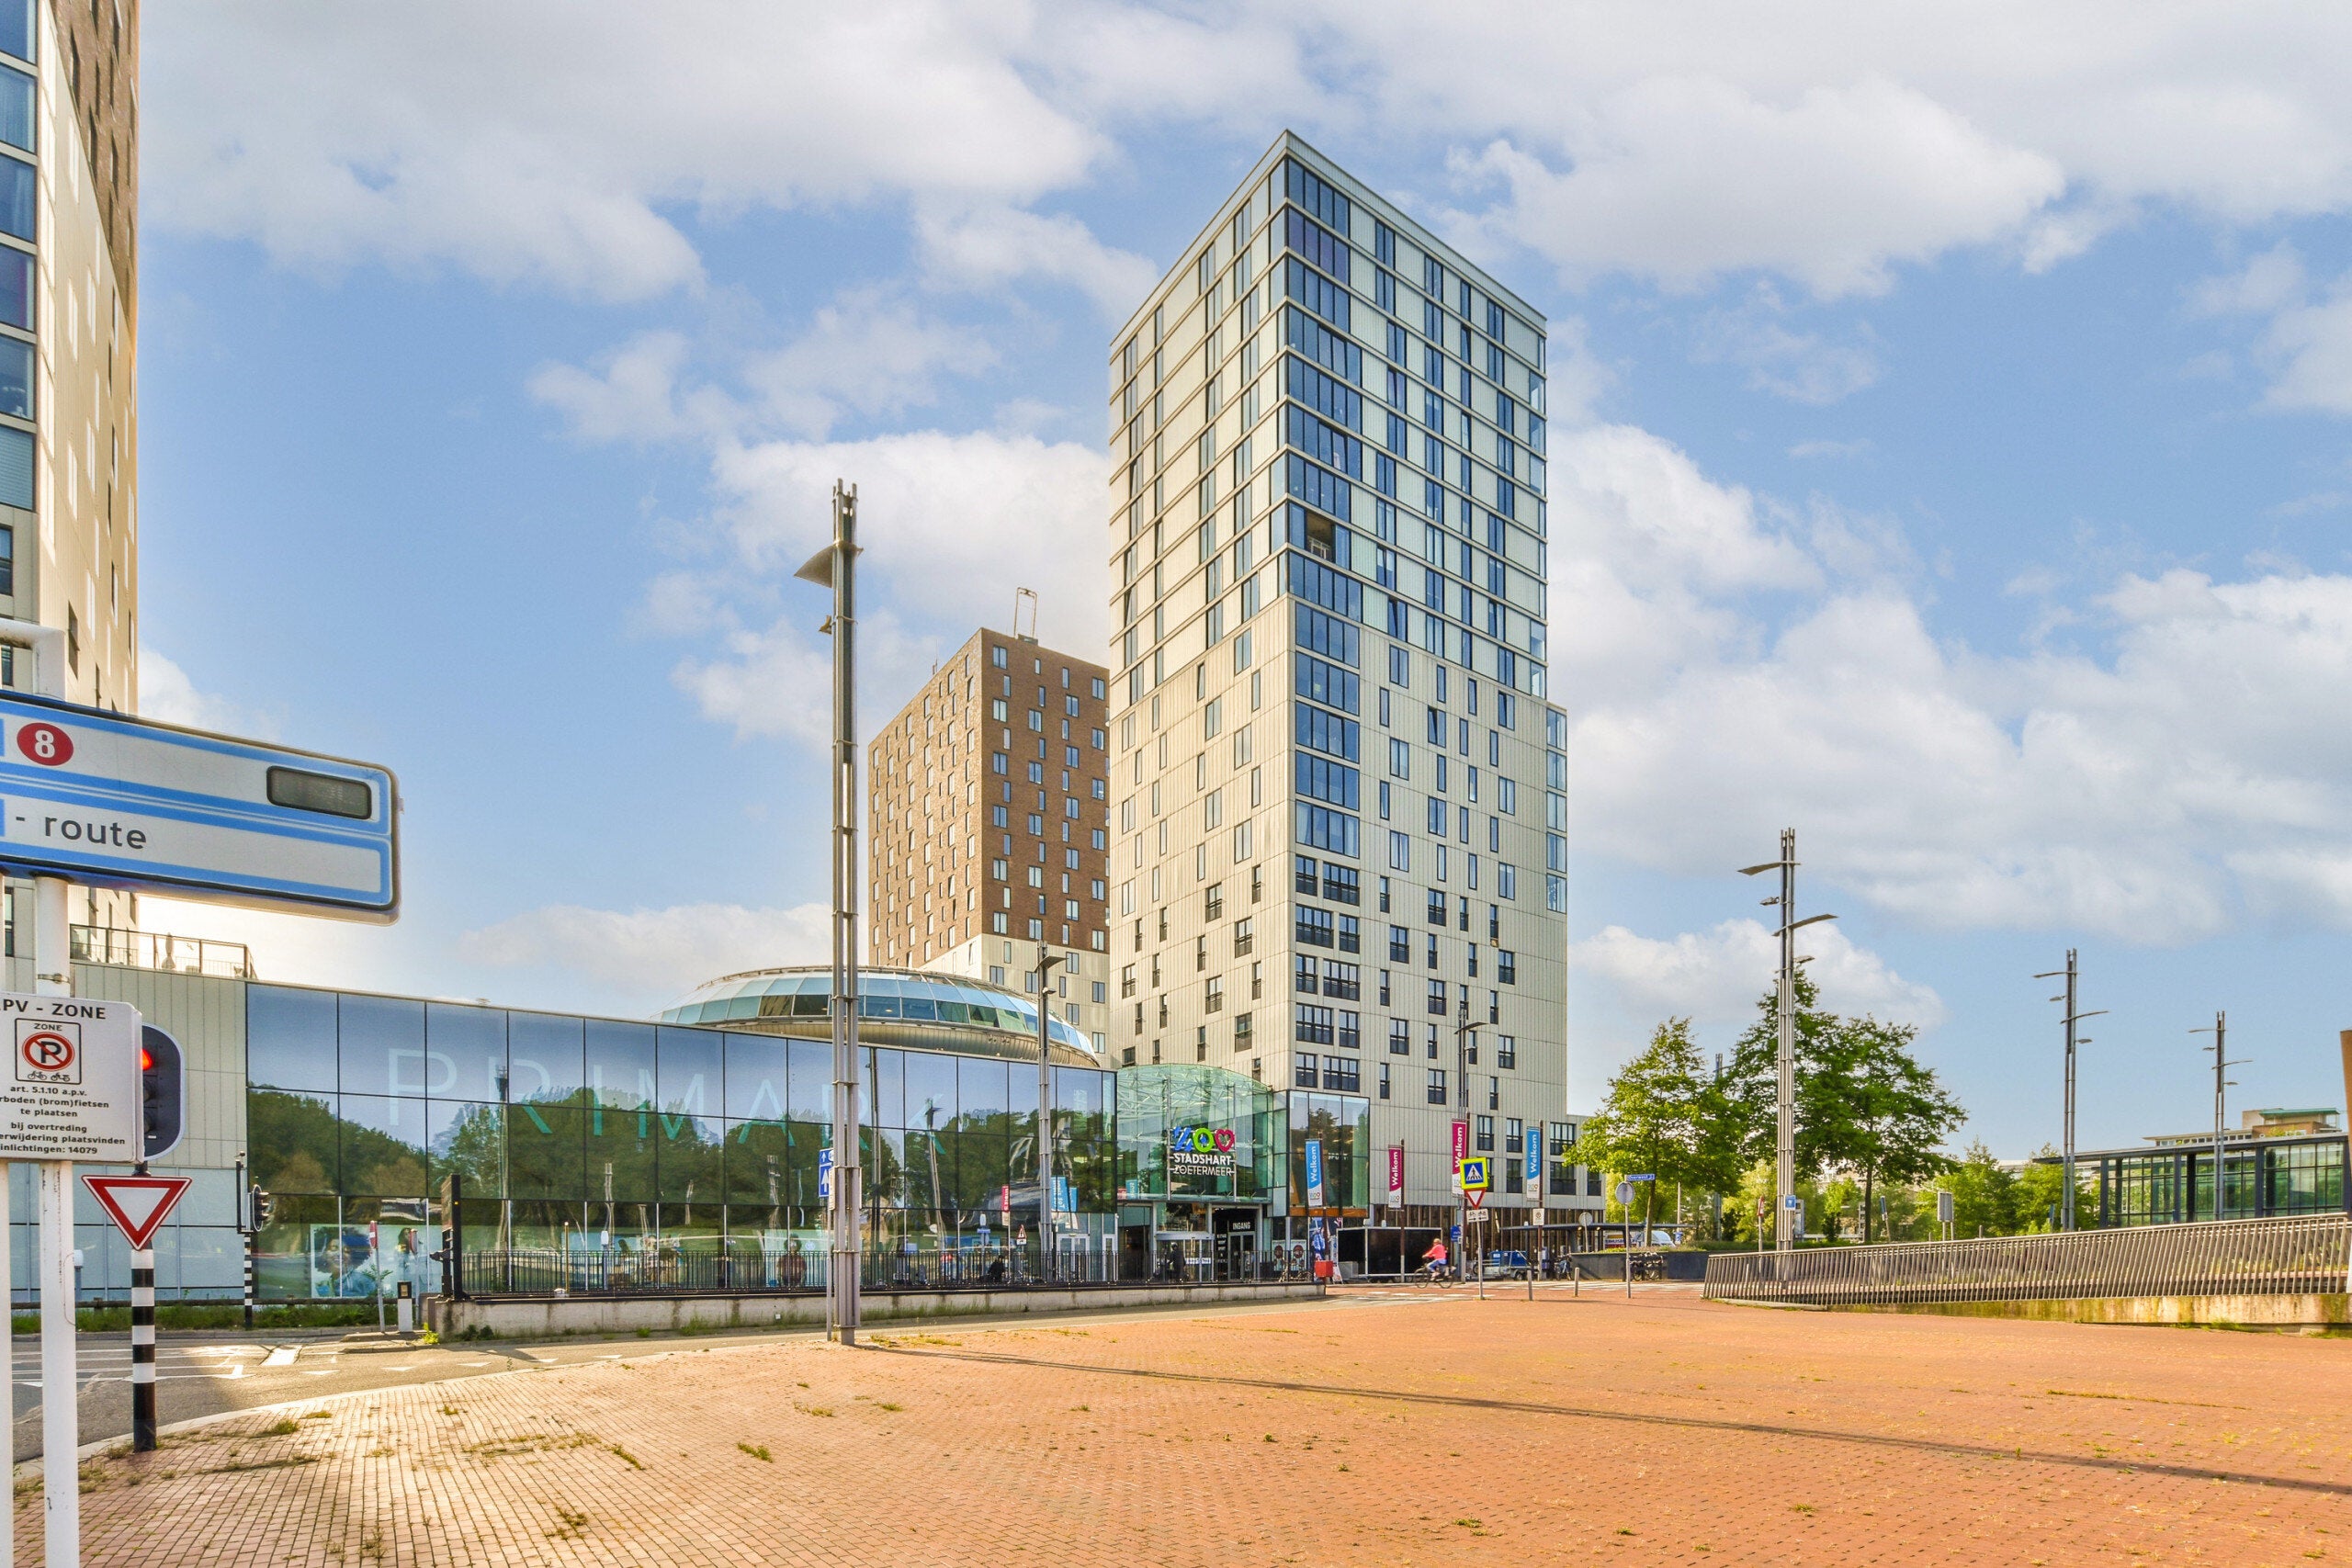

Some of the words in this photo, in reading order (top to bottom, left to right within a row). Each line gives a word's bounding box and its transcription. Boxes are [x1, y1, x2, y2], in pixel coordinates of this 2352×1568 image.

[34, 729, 56, 759] 8
[44, 816, 147, 850] route
[0, 998, 28, 1013] PV
[51, 1003, 107, 1020] ZONE
[34, 1022, 62, 1032] ZONE
[32, 1087, 59, 1095] 5.1.10
[62, 1089, 87, 1097] a.p.v.
[39, 1098, 109, 1108] (brom)fietsen
[34, 1109, 78, 1117] plaatsen
[11, 1122, 24, 1131] bij
[28, 1124, 87, 1134] overtreding
[62, 1135, 125, 1145] plaatsvinden
[0, 1144, 65, 1154] inlichtingen:
[69, 1146, 97, 1155] 14079
[1455, 1126, 1464, 1168] Welkom
[1172, 1153, 1232, 1166] STADSHART
[1172, 1164, 1232, 1177] ZOETERMEER
[1232, 1222, 1251, 1231] INGANG
